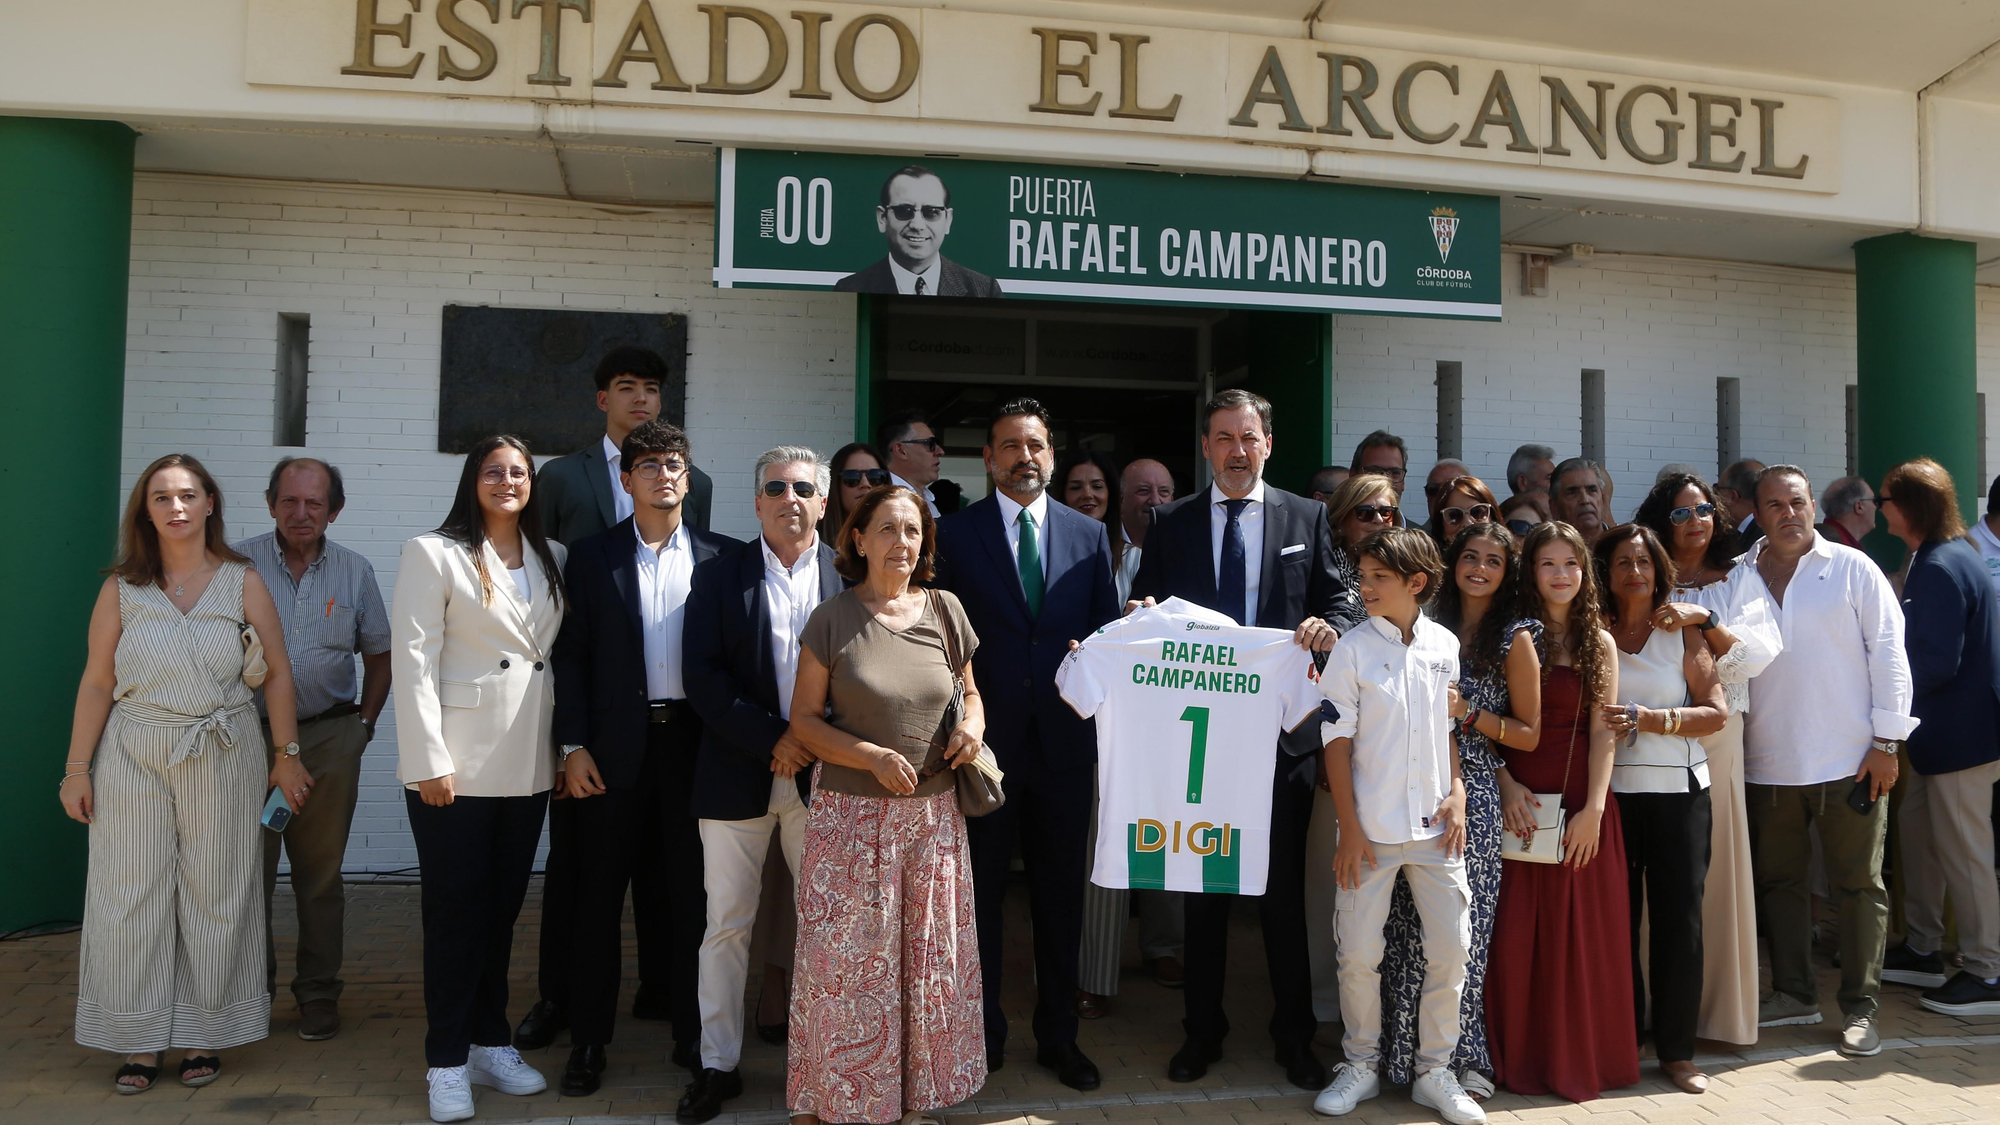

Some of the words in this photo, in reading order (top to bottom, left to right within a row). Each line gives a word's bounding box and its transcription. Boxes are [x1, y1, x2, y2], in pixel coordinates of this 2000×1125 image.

[340, 0, 921, 103] ESTADIO
[1029, 27, 1182, 121] EL
[1228, 46, 1809, 179] ARCANGEL
[777, 176, 833, 246] 00
[1009, 175, 1096, 217] PUERTA
[760, 208, 774, 238] PUERTA
[1008, 219, 1147, 275] RAFAEL
[1159, 227, 1388, 288] CAMPANERO
[1445, 280, 1472, 289] FÚTBOL
[1161, 641, 1238, 667] RAFAEL
[1132, 663, 1261, 694] CAMPANERO
[1179, 706, 1210, 804] 1
[1136, 817, 1231, 856] DIGI
